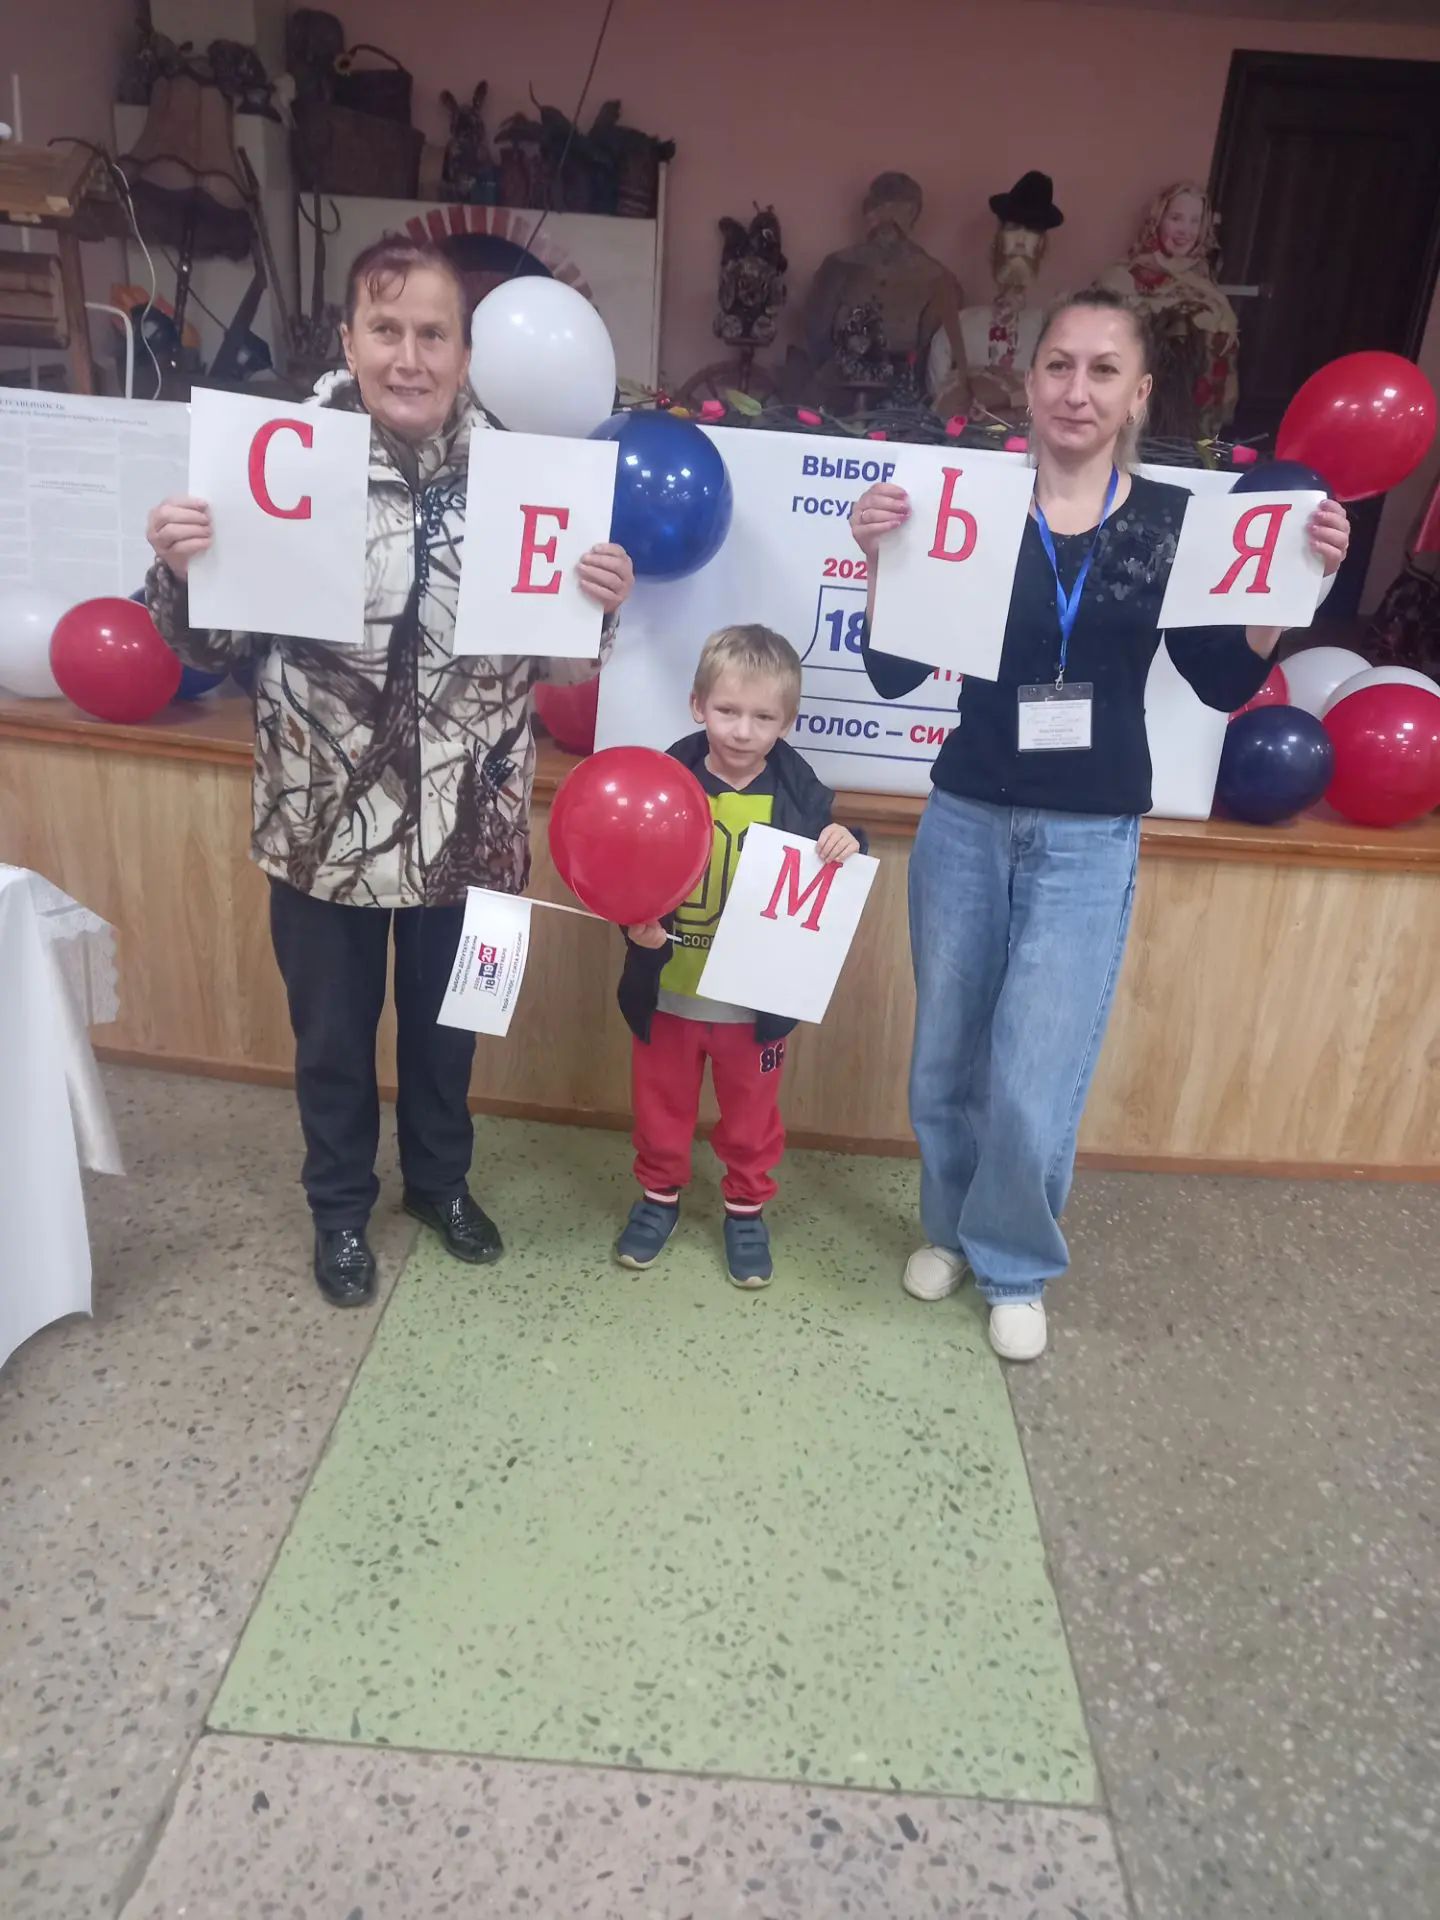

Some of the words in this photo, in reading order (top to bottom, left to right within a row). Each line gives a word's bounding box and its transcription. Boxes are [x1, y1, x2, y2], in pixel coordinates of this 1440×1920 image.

[248, 418, 313, 520] С
[802, 455, 895, 483] ВЫБОР
[928, 467, 977, 562] Ь
[511, 504, 569, 594] Е
[1209, 504, 1292, 594] Я
[825, 609, 866, 654] 18
[795, 714, 880, 739] ГОЛОС
[910, 725, 957, 745] СИ
[760, 845, 843, 931] М
[481, 947, 493, 962] 20
[683, 935, 714, 948] COO
[483, 964, 494, 976] 19
[485, 979, 496, 990] 18
